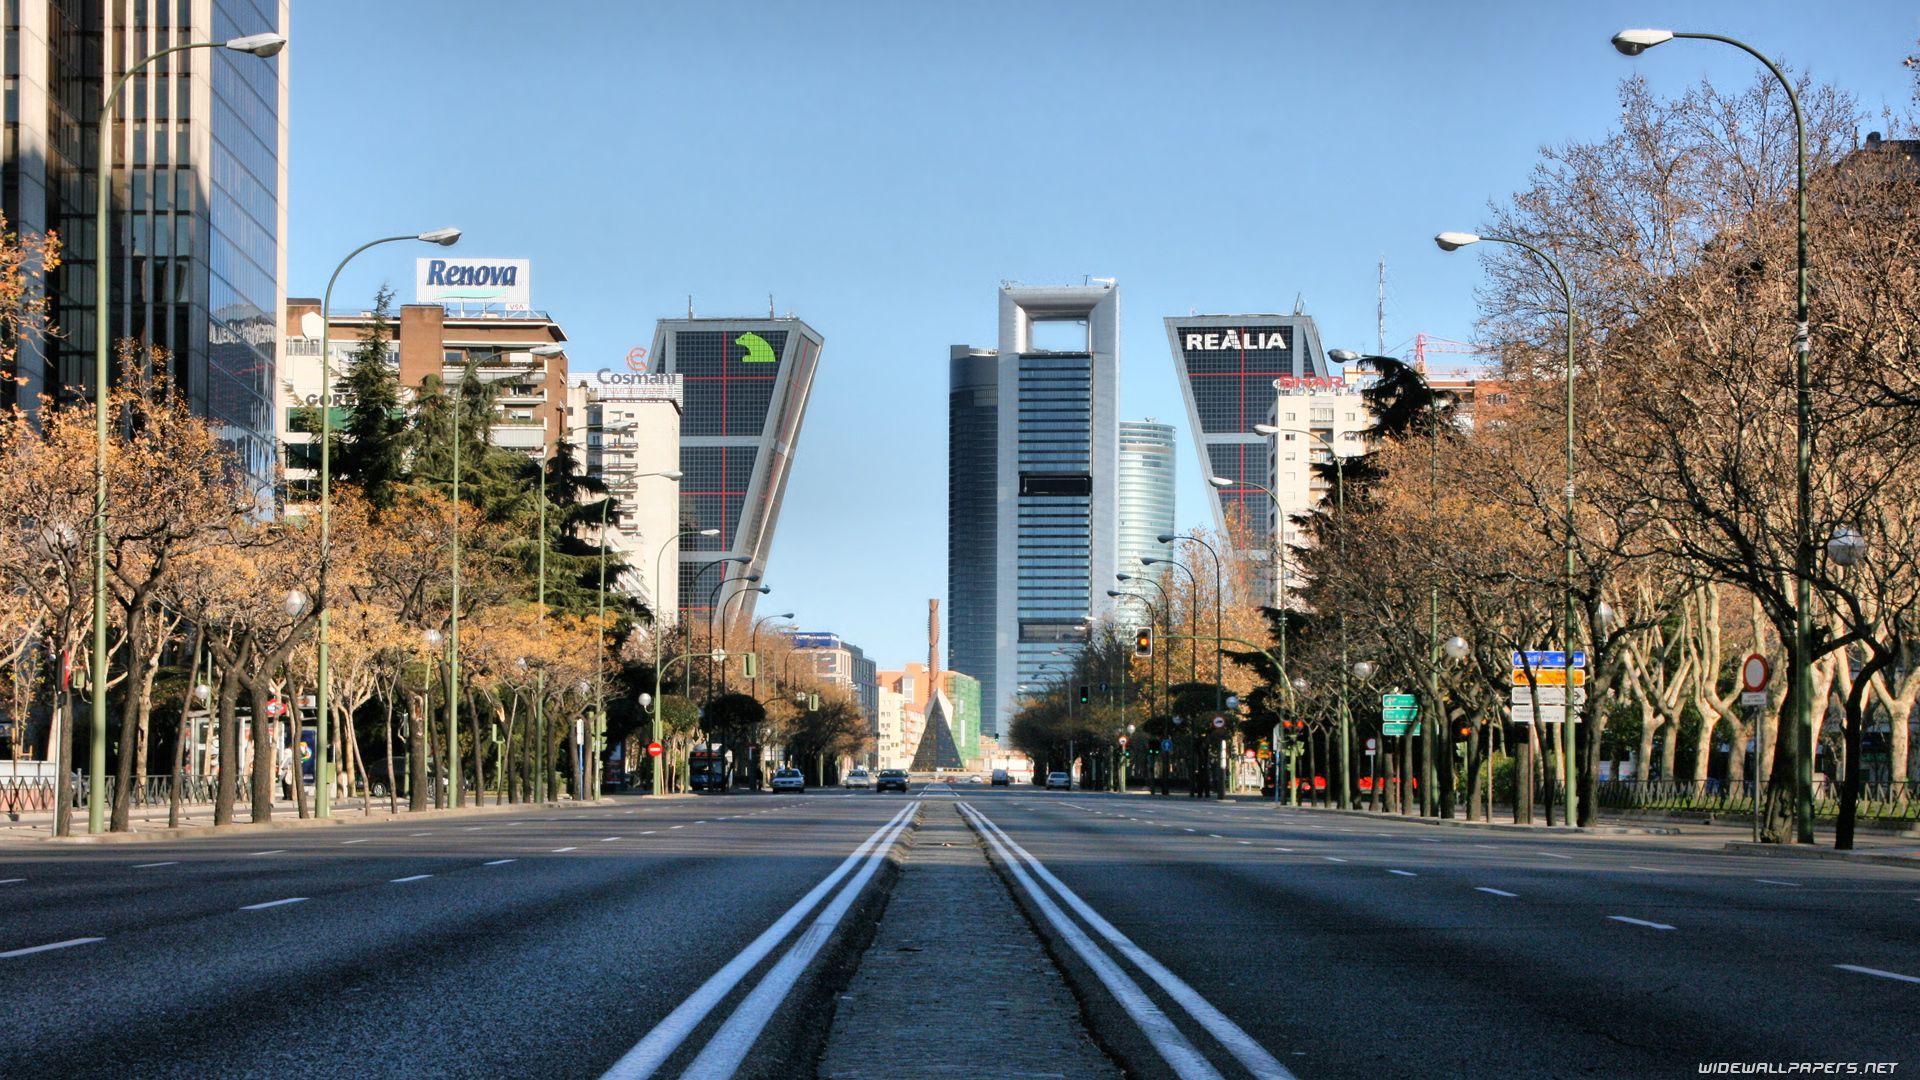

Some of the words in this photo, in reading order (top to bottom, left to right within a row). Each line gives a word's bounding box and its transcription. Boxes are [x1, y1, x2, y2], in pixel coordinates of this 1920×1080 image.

[426, 260, 518, 287] Renova
[1186, 329, 1287, 350] REALIA
[597, 368, 676, 385] Cosmani
[1280, 376, 1349, 389] SHAR
